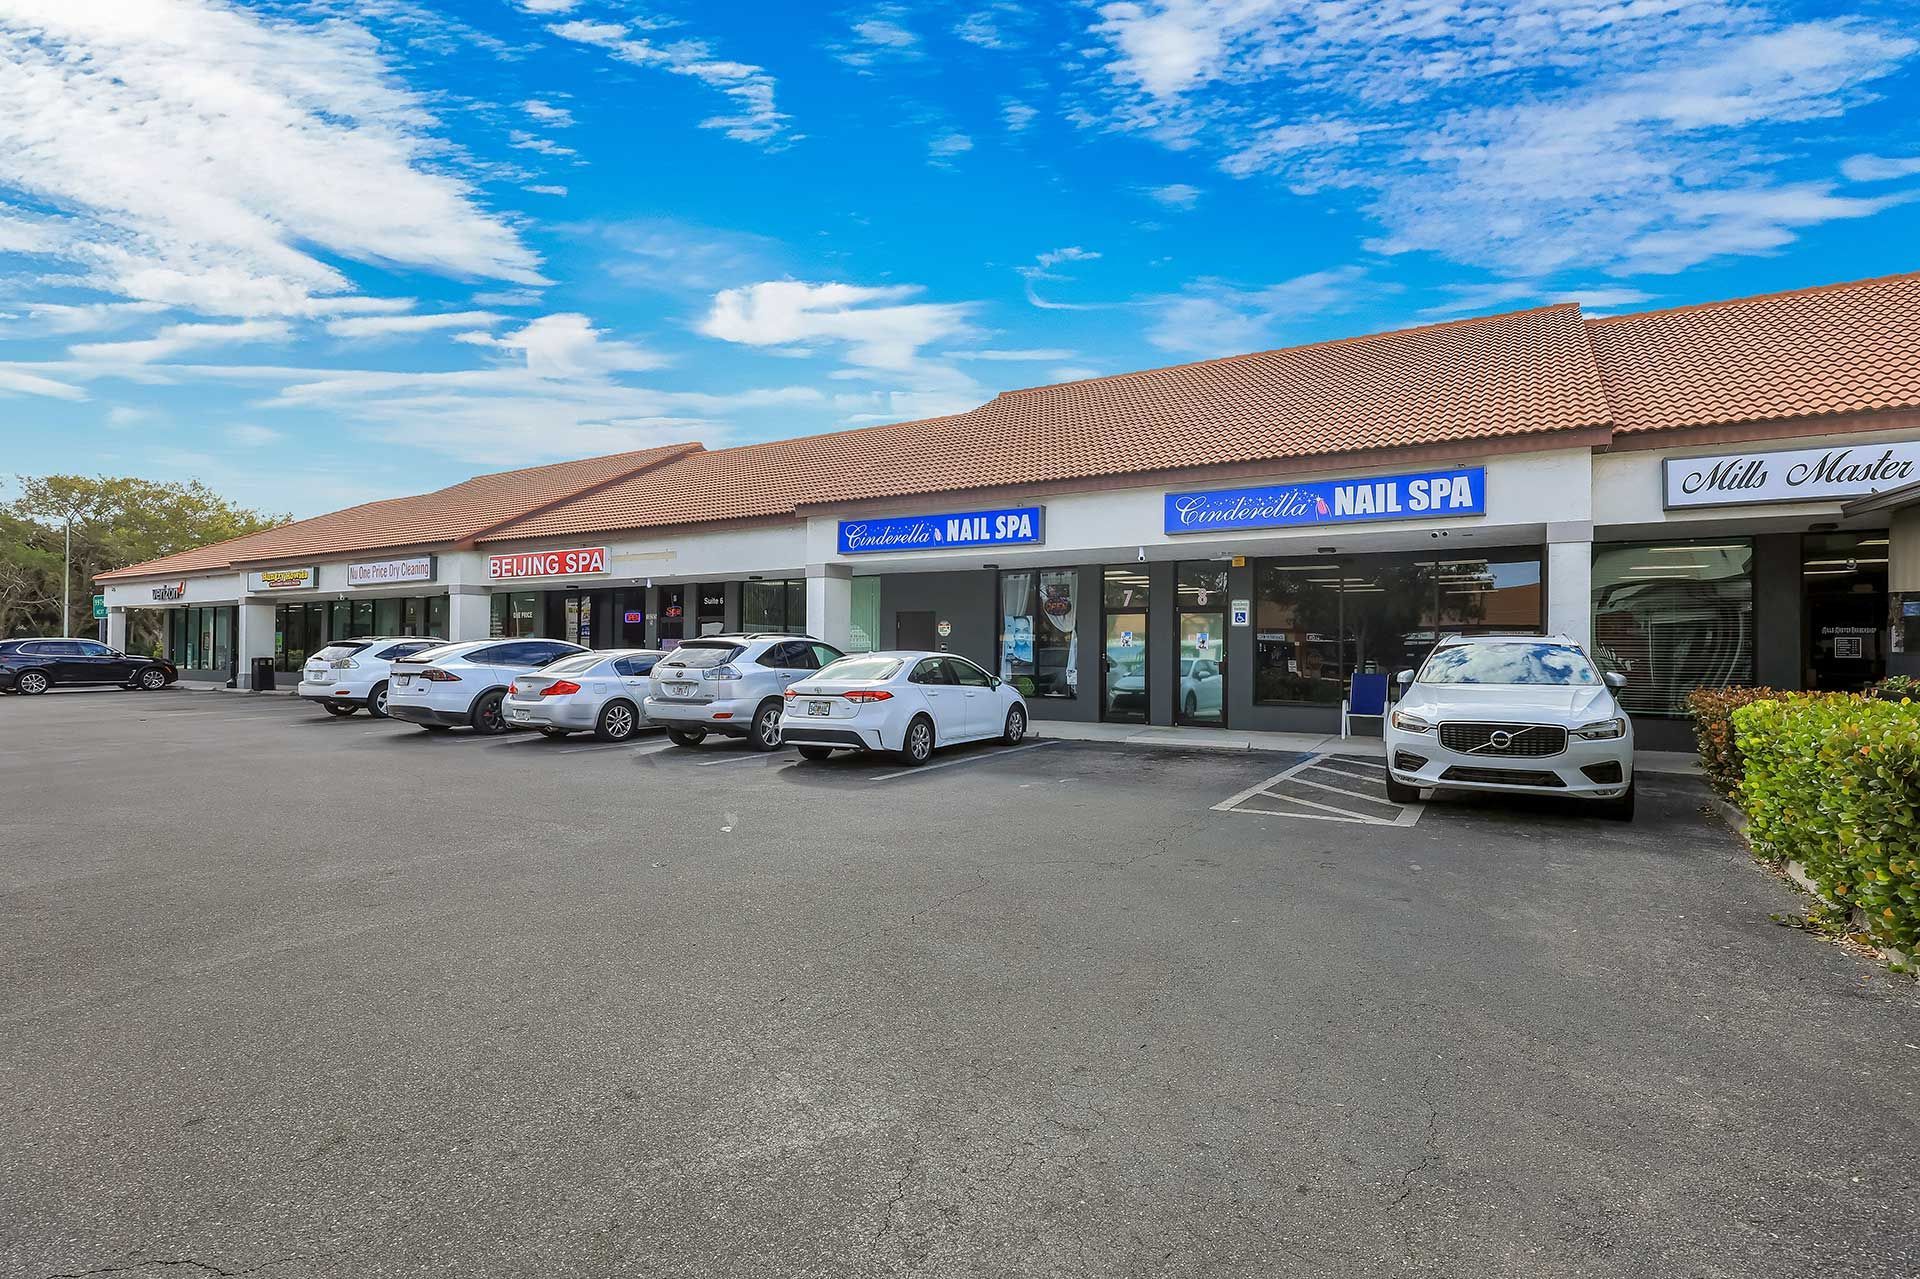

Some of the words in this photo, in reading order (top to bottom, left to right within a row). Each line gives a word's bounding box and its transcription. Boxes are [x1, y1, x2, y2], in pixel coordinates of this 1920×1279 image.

[1682, 458, 1768, 494] Mills
[1785, 449, 1914, 486] Master
[1176, 491, 1309, 526] Cinderella
[1334, 483, 1401, 516] NAIL
[1408, 476, 1473, 512] SPA
[845, 522, 929, 549] Cinderella
[946, 518, 990, 542] NAIL
[995, 514, 1032, 539] SPA
[359, 566, 370, 579] One
[372, 565, 387, 578] Price
[389, 563, 399, 579] Dry
[401, 561, 429, 577] Cleaning
[490, 555, 559, 577] BEIJING
[565, 552, 602, 573] SPA
[151, 584, 181, 600] verizon
[703, 597, 718, 605] Suite
[719, 597, 724, 605] 6
[1123, 589, 1133, 607] 7
[1197, 587, 1208, 606] 8
